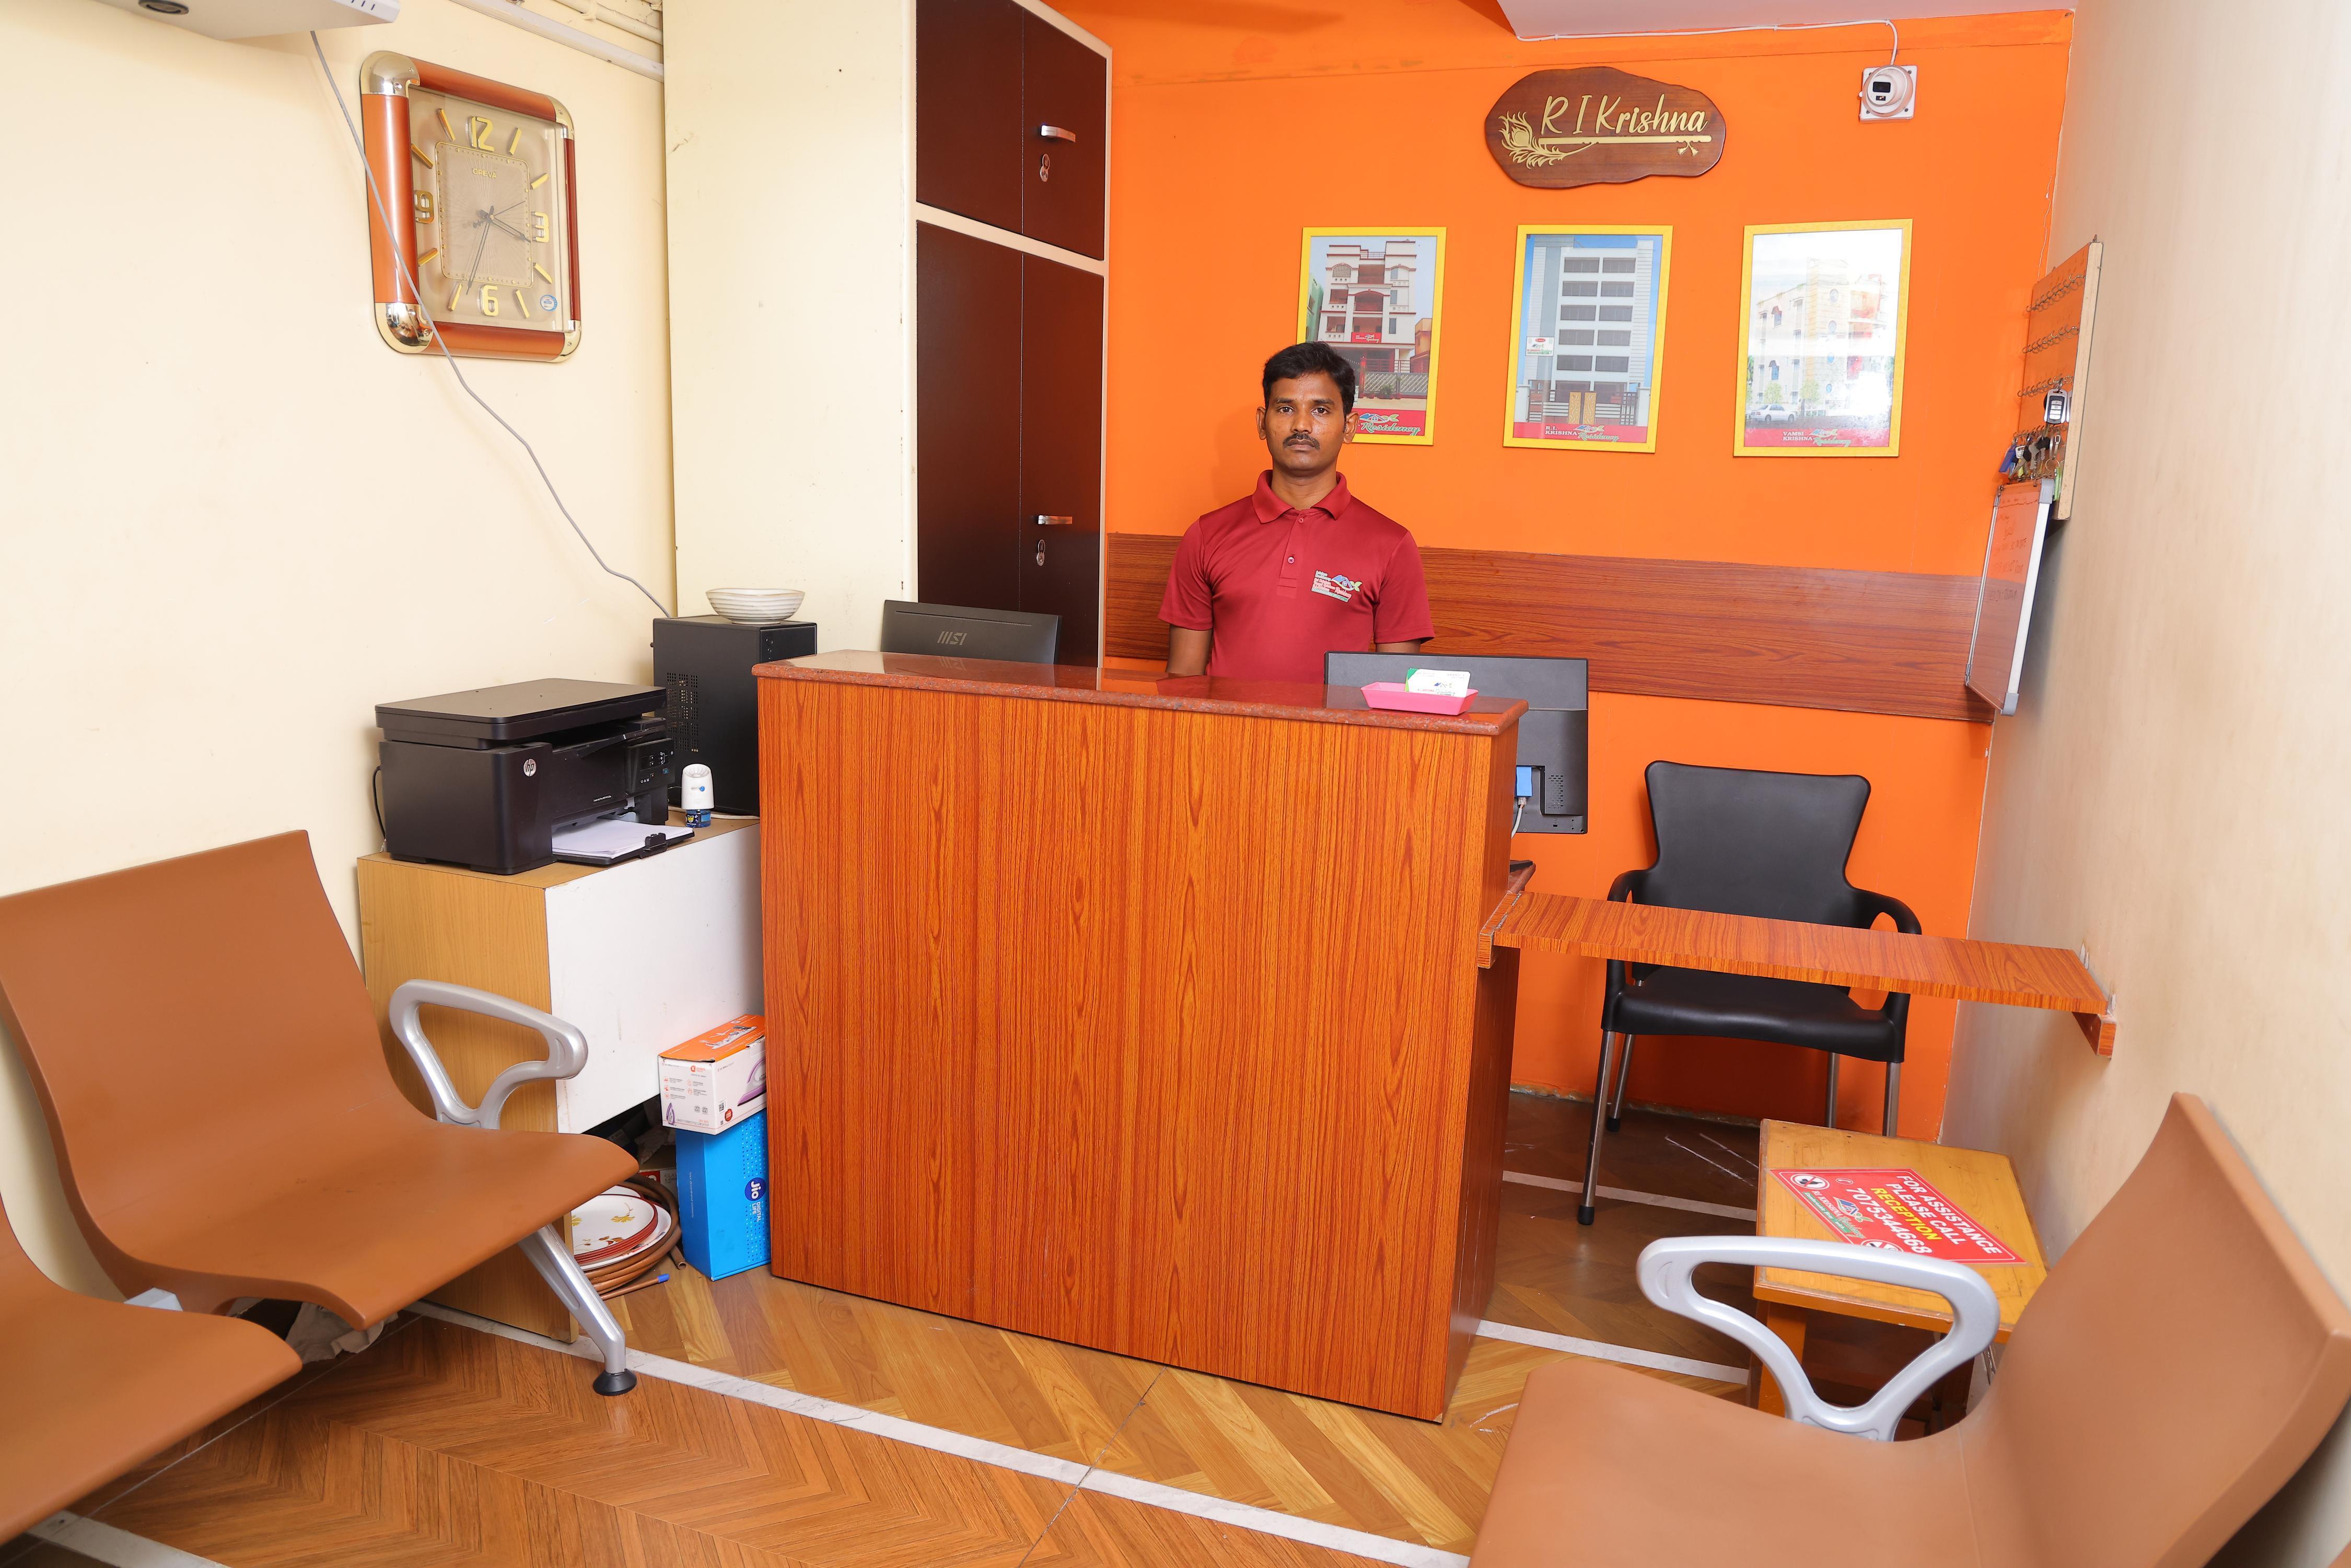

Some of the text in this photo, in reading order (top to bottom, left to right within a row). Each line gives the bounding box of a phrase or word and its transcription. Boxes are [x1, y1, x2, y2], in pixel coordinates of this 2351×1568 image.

[1541, 93, 1708, 135] R I Krishna
[470, 117, 495, 152] 12
[472, 168, 497, 179] OREVA
[414, 190, 434, 224] 9
[532, 212, 549, 243] 3
[481, 285, 499, 317] 6
[1360, 422, 1421, 436] Residency
[1578, 432, 1619, 442] Residency
[937, 631, 968, 646] MSI
[526, 759, 534, 776] hp
[750, 1181, 762, 1200] Jio
[1818, 1194, 1843, 1217] KRISHNA
[1845, 1187, 1933, 1254] 7075344668
[1870, 1187, 1943, 1240] RECEPTION
[1885, 1183, 1966, 1245] PLEASE CALL
[1896, 1176, 2003, 1254] FOR ASSISTANCE
